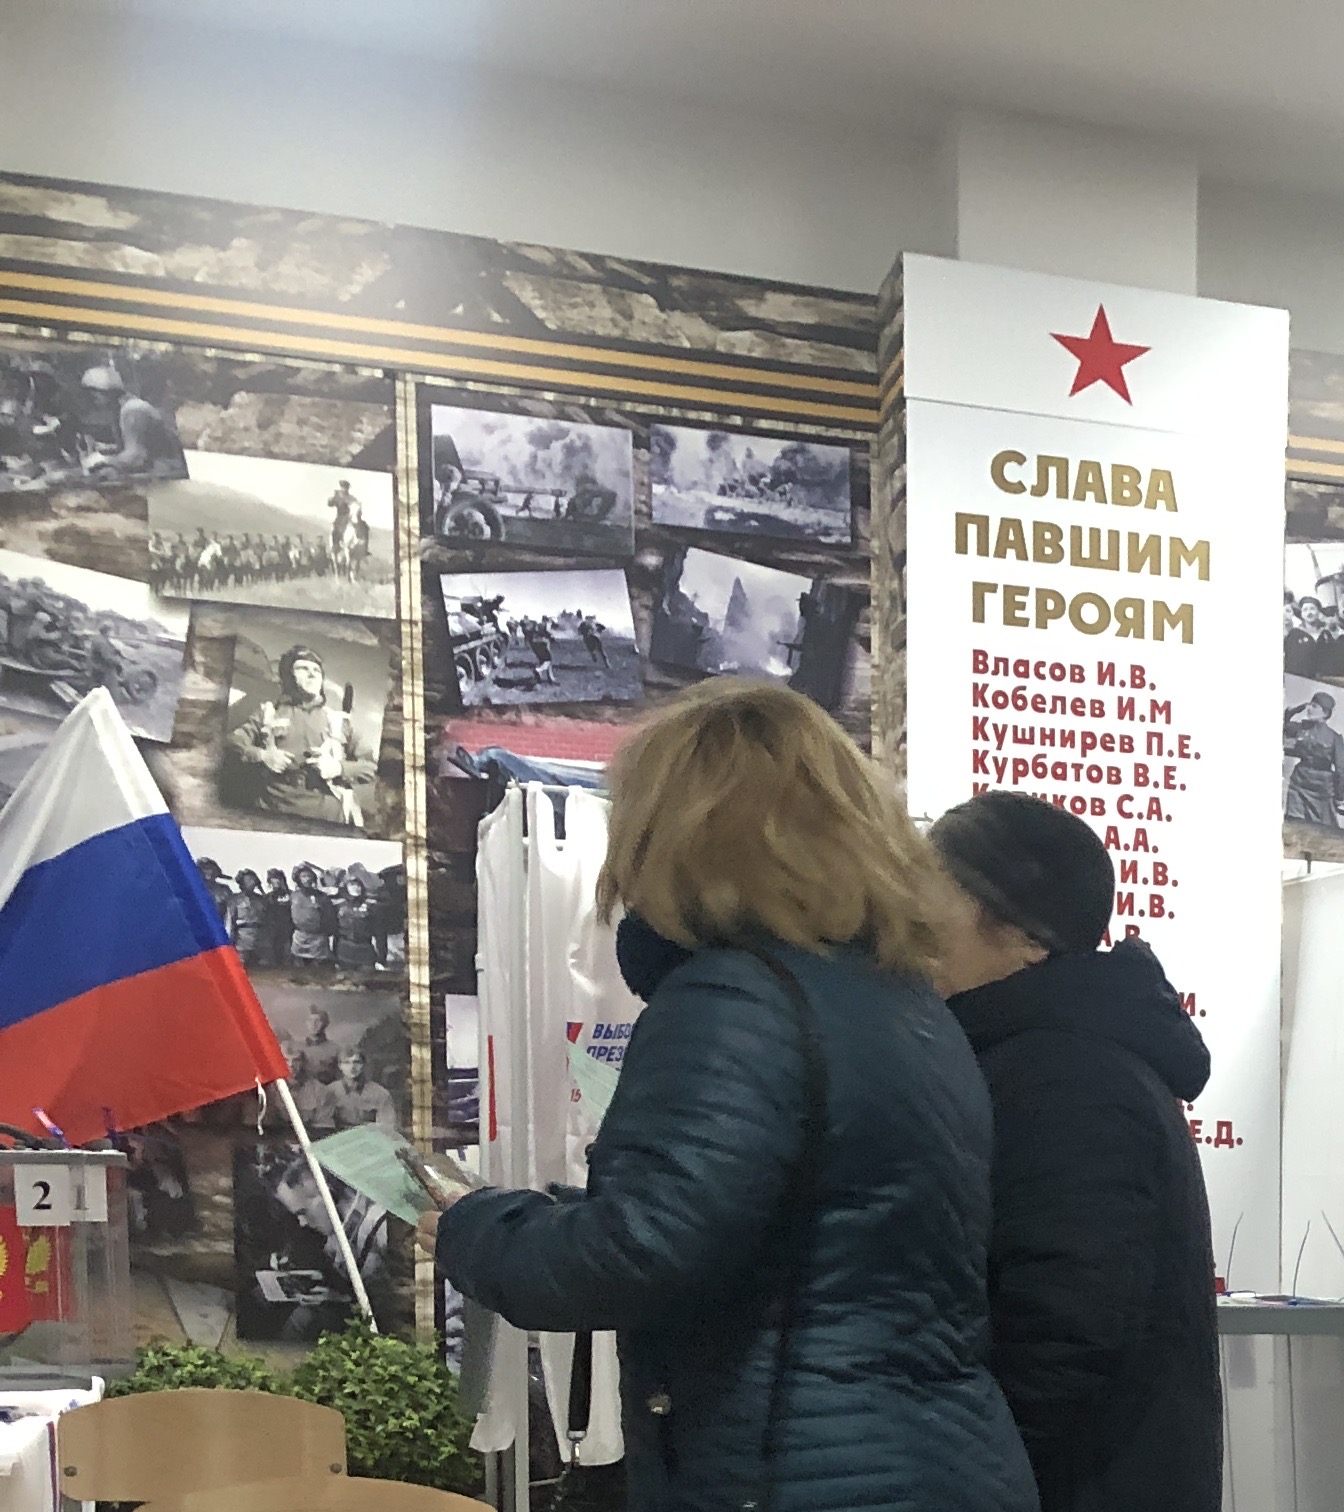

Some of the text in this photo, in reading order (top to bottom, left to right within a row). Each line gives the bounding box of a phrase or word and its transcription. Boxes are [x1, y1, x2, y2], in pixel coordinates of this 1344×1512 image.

[990, 449, 1179, 512] СЛАВА
[954, 511, 1210, 582] ПАВШИМ
[971, 581, 1194, 645] ГЕРОЯМ
[972, 648, 1156, 691] Власов И.В.
[972, 682, 1172, 724] Кобелев И.М
[972, 716, 1201, 760] Кушнирев П.Е.
[972, 749, 1187, 791] Курбатов В.Е.
[1116, 794, 1172, 822] С.А.
[1104, 825, 1159, 853] А.А.
[1120, 859, 1179, 887] И.В.
[1116, 891, 1175, 919] И.В.
[32, 1180, 53, 1211] 2
